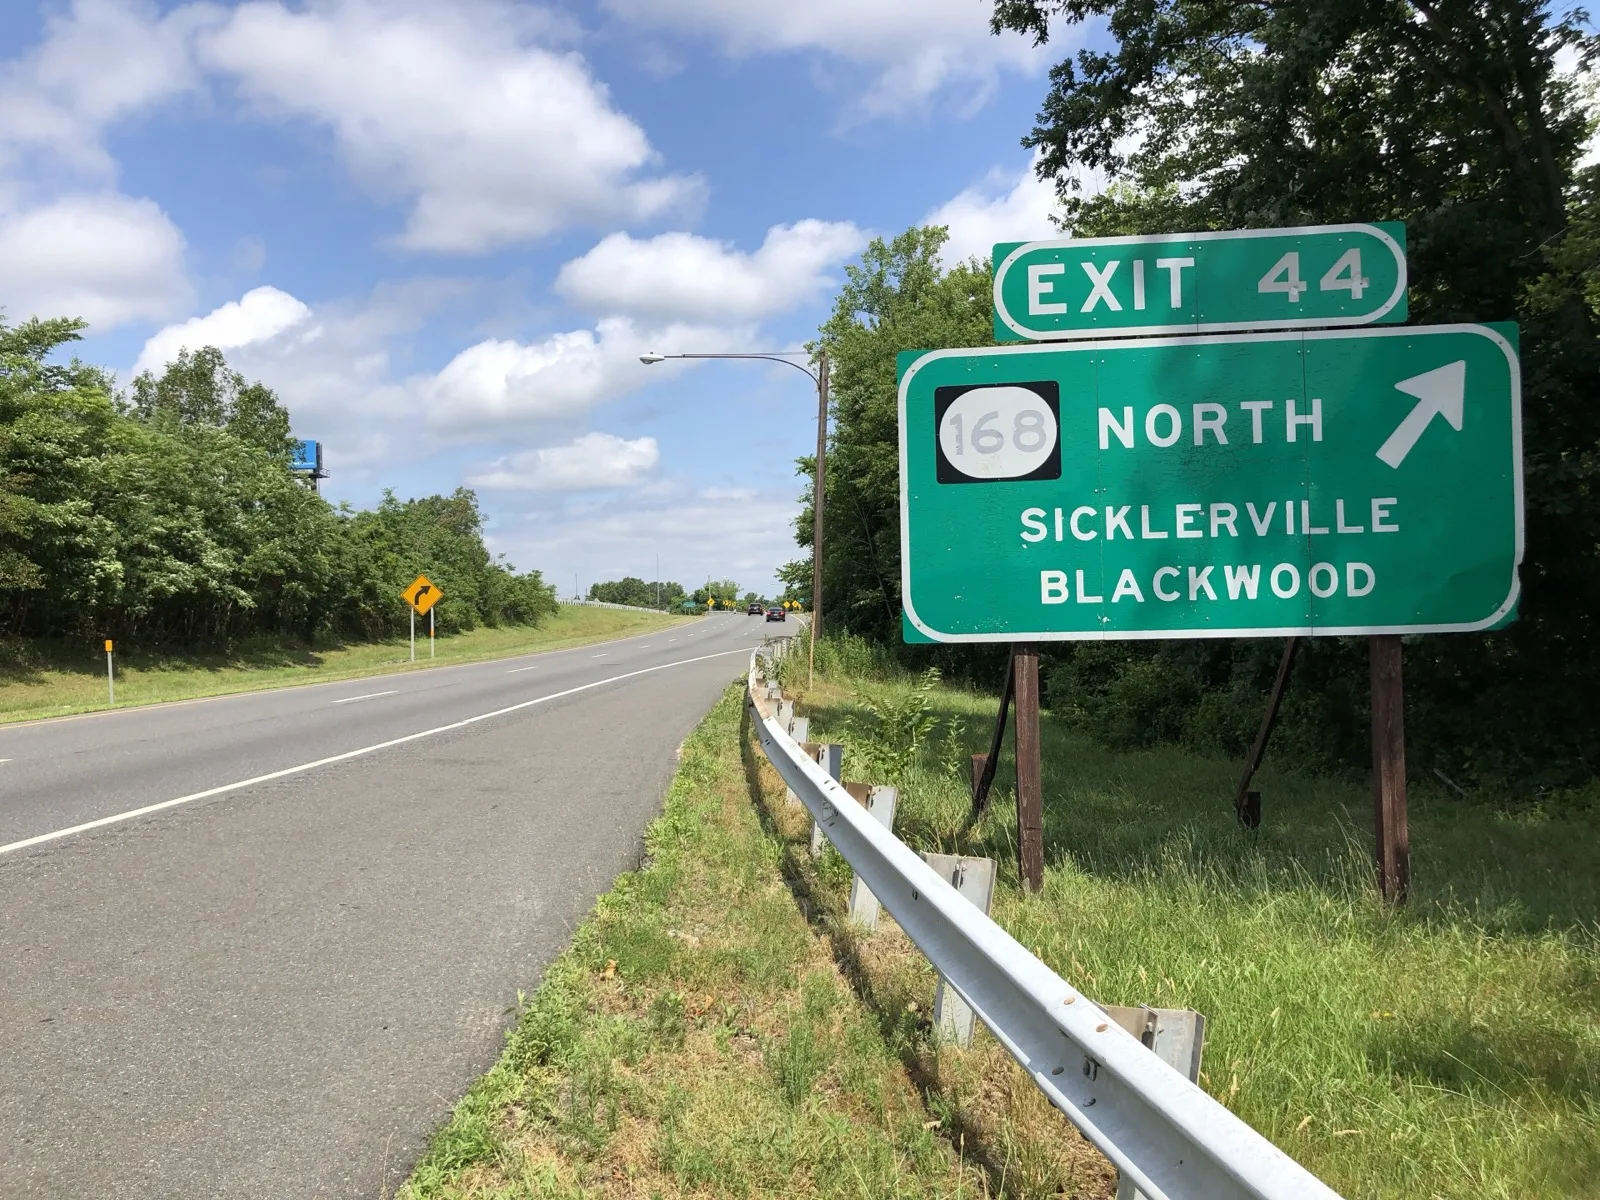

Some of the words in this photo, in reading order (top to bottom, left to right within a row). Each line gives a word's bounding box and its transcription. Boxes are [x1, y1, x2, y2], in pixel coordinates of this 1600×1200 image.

[1027, 256, 1195, 315] EXIT
[1257, 247, 1370, 303] 44
[948, 409, 1047, 456] 168
[1099, 398, 1324, 450] NORTH
[1020, 497, 1399, 544] SICKLERVILLE
[1040, 562, 1376, 605] BLACKWOOD
